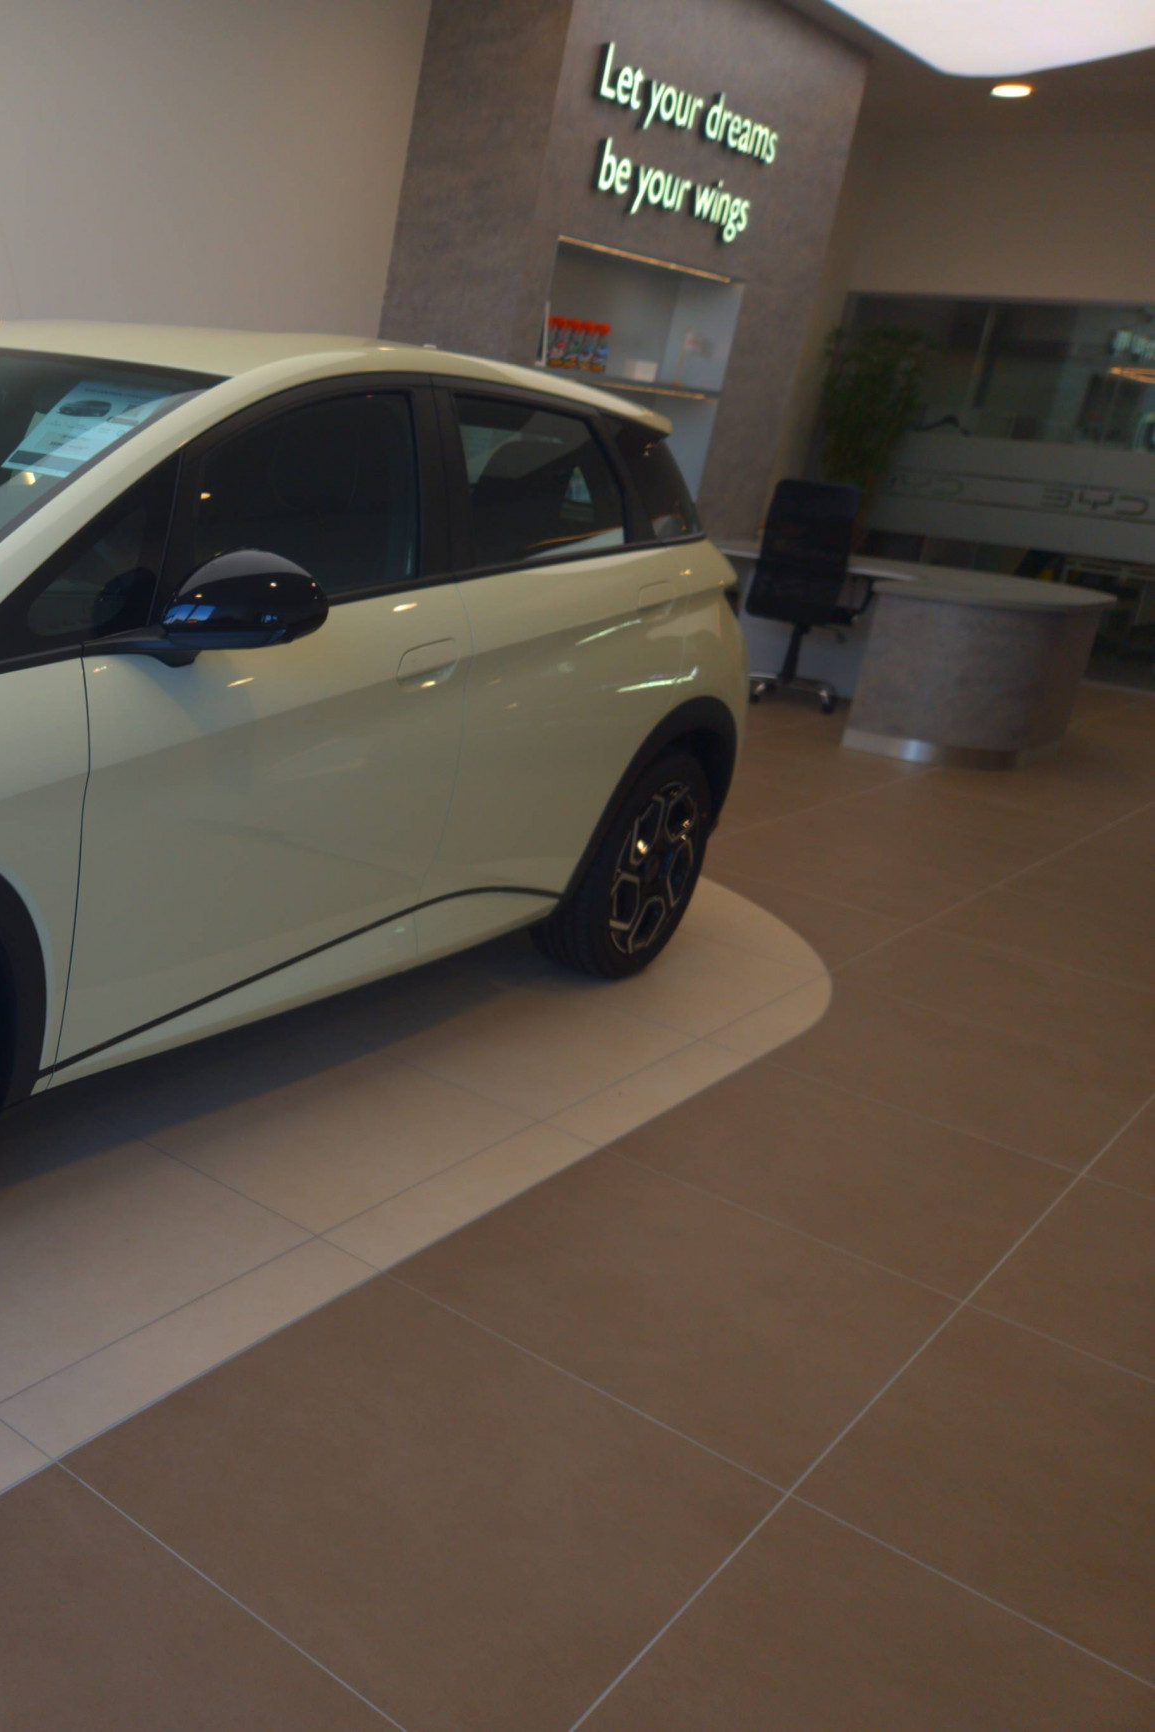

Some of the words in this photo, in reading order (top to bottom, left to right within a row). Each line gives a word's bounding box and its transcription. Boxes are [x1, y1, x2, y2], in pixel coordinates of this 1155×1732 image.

[599, 41, 643, 111] Let
[643, 79, 703, 130] your
[705, 92, 778, 164] dreams
[597, 137, 632, 194] be
[630, 165, 691, 215] your
[694, 180, 750, 243] wings
